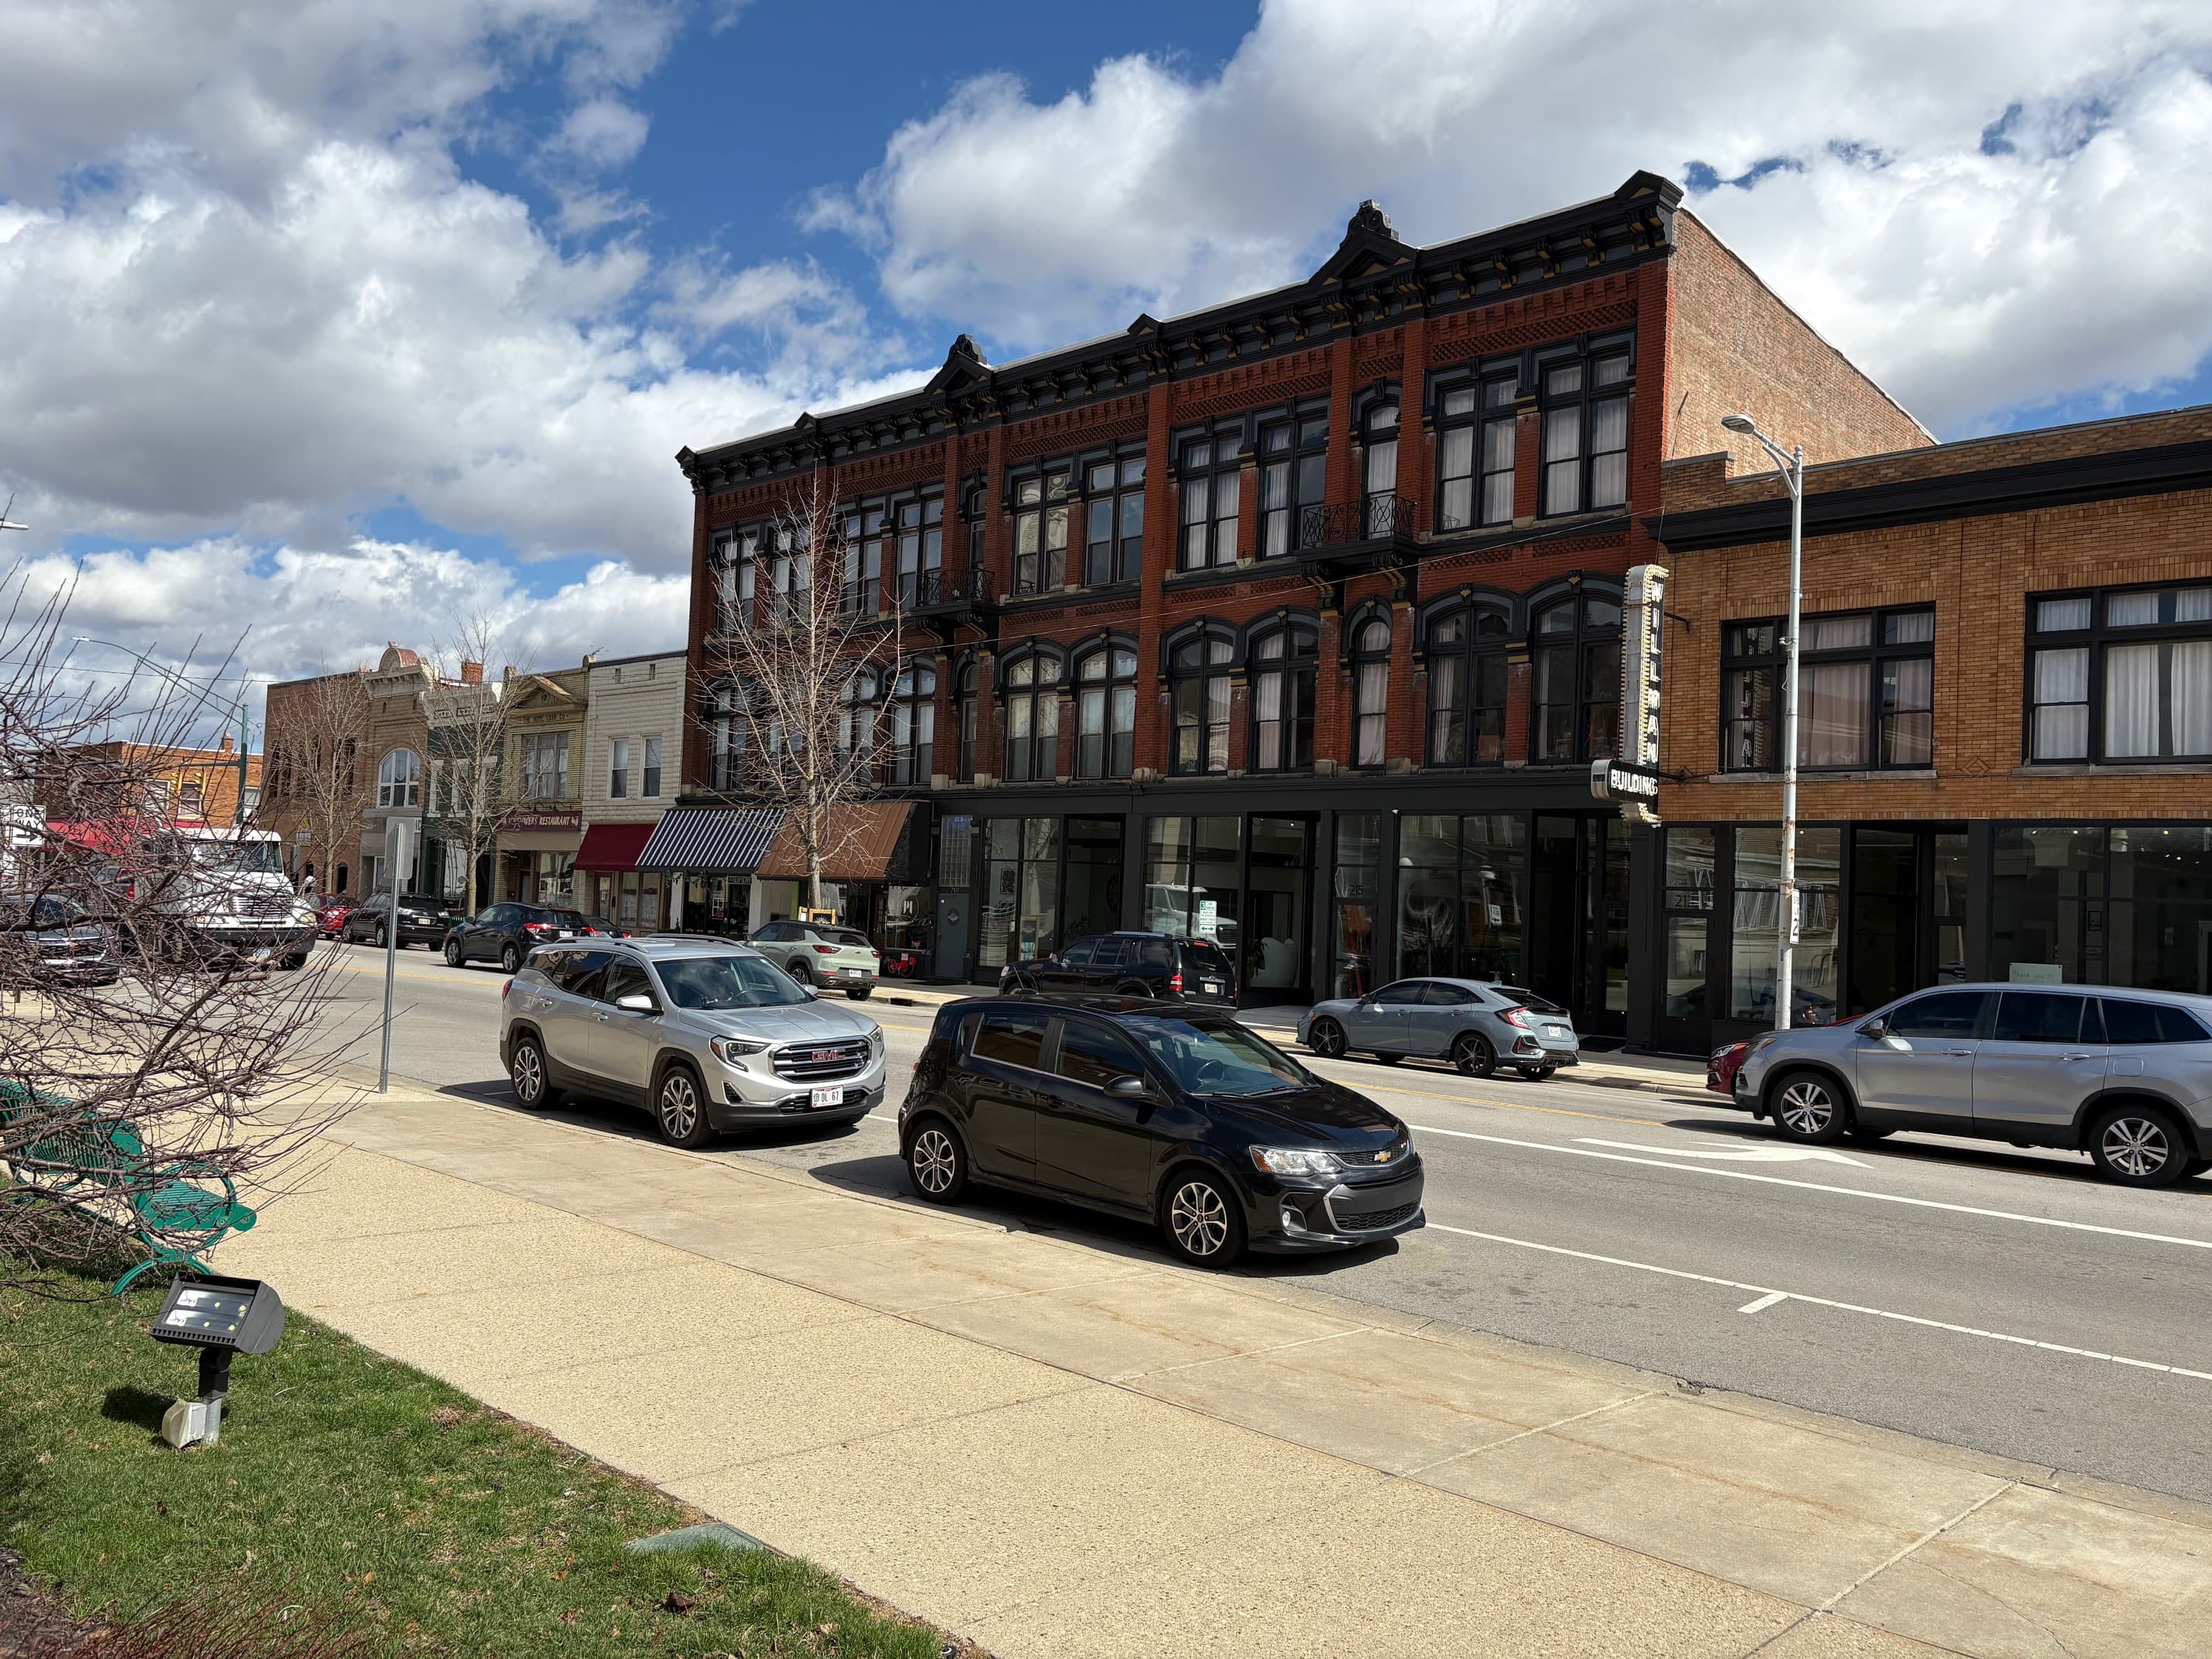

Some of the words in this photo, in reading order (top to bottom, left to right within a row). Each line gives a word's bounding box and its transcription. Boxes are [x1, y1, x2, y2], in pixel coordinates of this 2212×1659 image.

[1647, 582, 1663, 764] WILLMAN
[1611, 769, 1657, 796] BUILDING
[539, 816, 571, 826] RESTAURANT
[1350, 884, 1363, 895] 215
[812, 1049, 846, 1062] GMC
[821, 1092, 828, 1102] DL
[831, 1091, 839, 1101] 67
